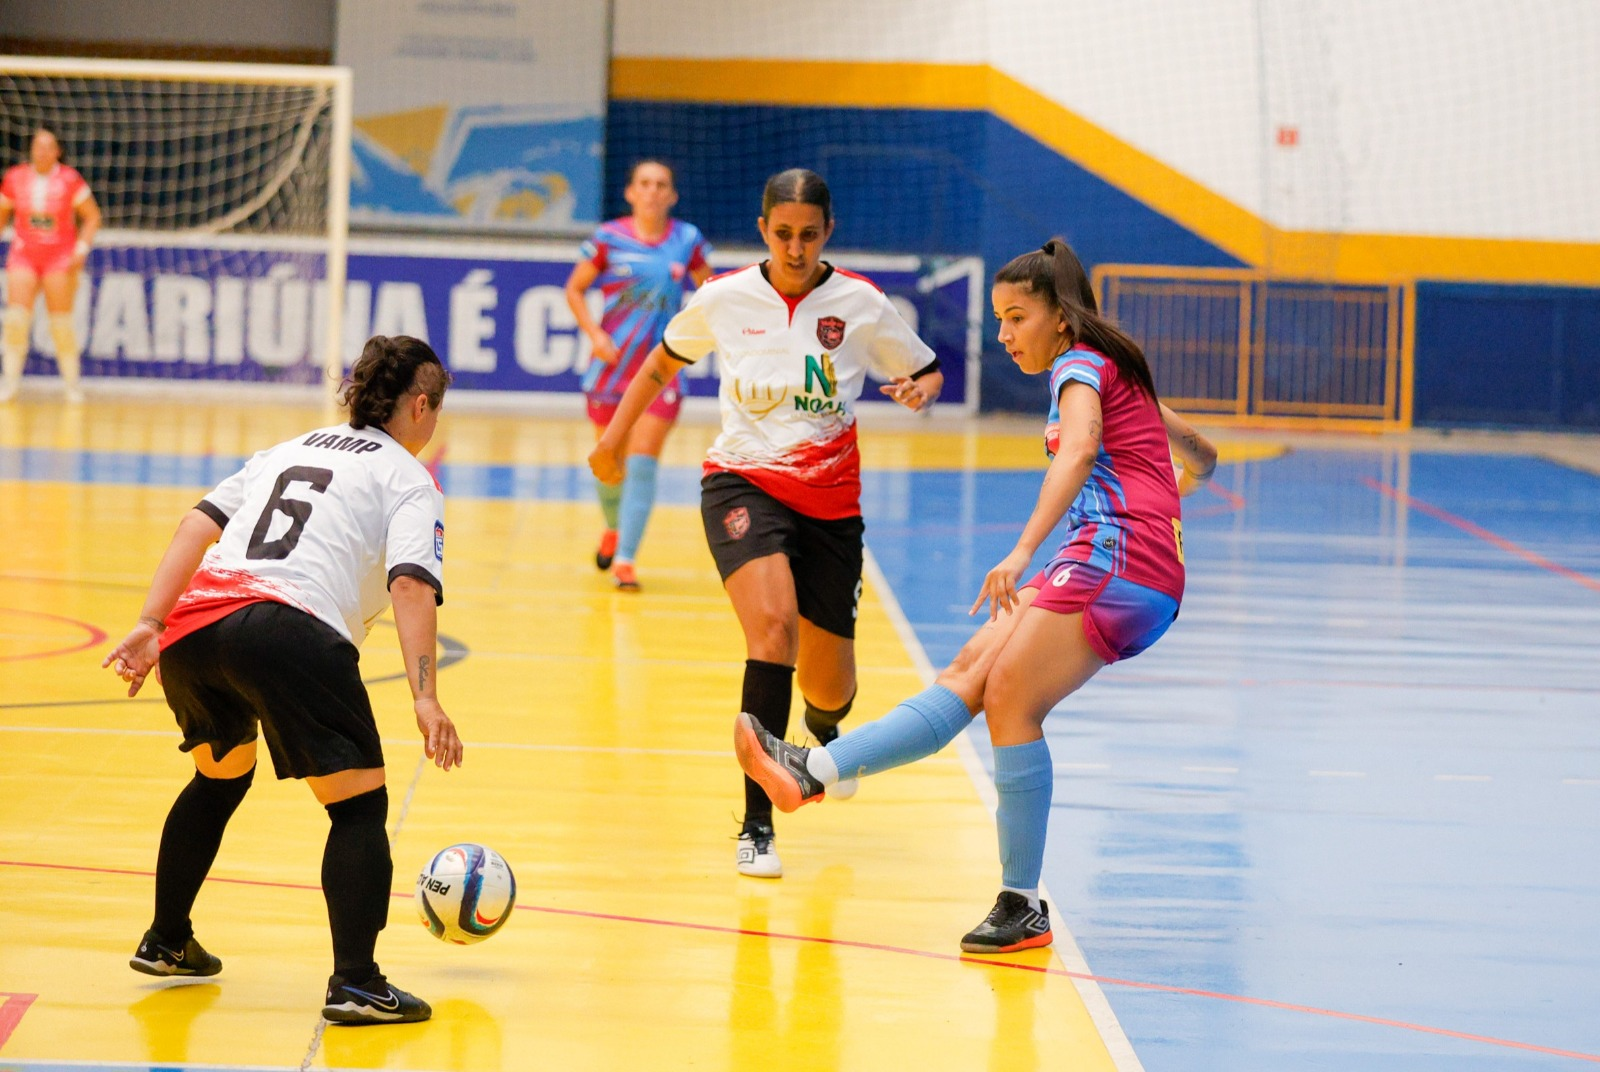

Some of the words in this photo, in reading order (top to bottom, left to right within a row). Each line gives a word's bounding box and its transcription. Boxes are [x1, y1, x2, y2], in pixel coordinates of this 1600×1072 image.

[448, 268, 498, 373] É
[302, 432, 383, 454] VAMP
[246, 465, 333, 560] 6
[1052, 561, 1079, 587] 6
